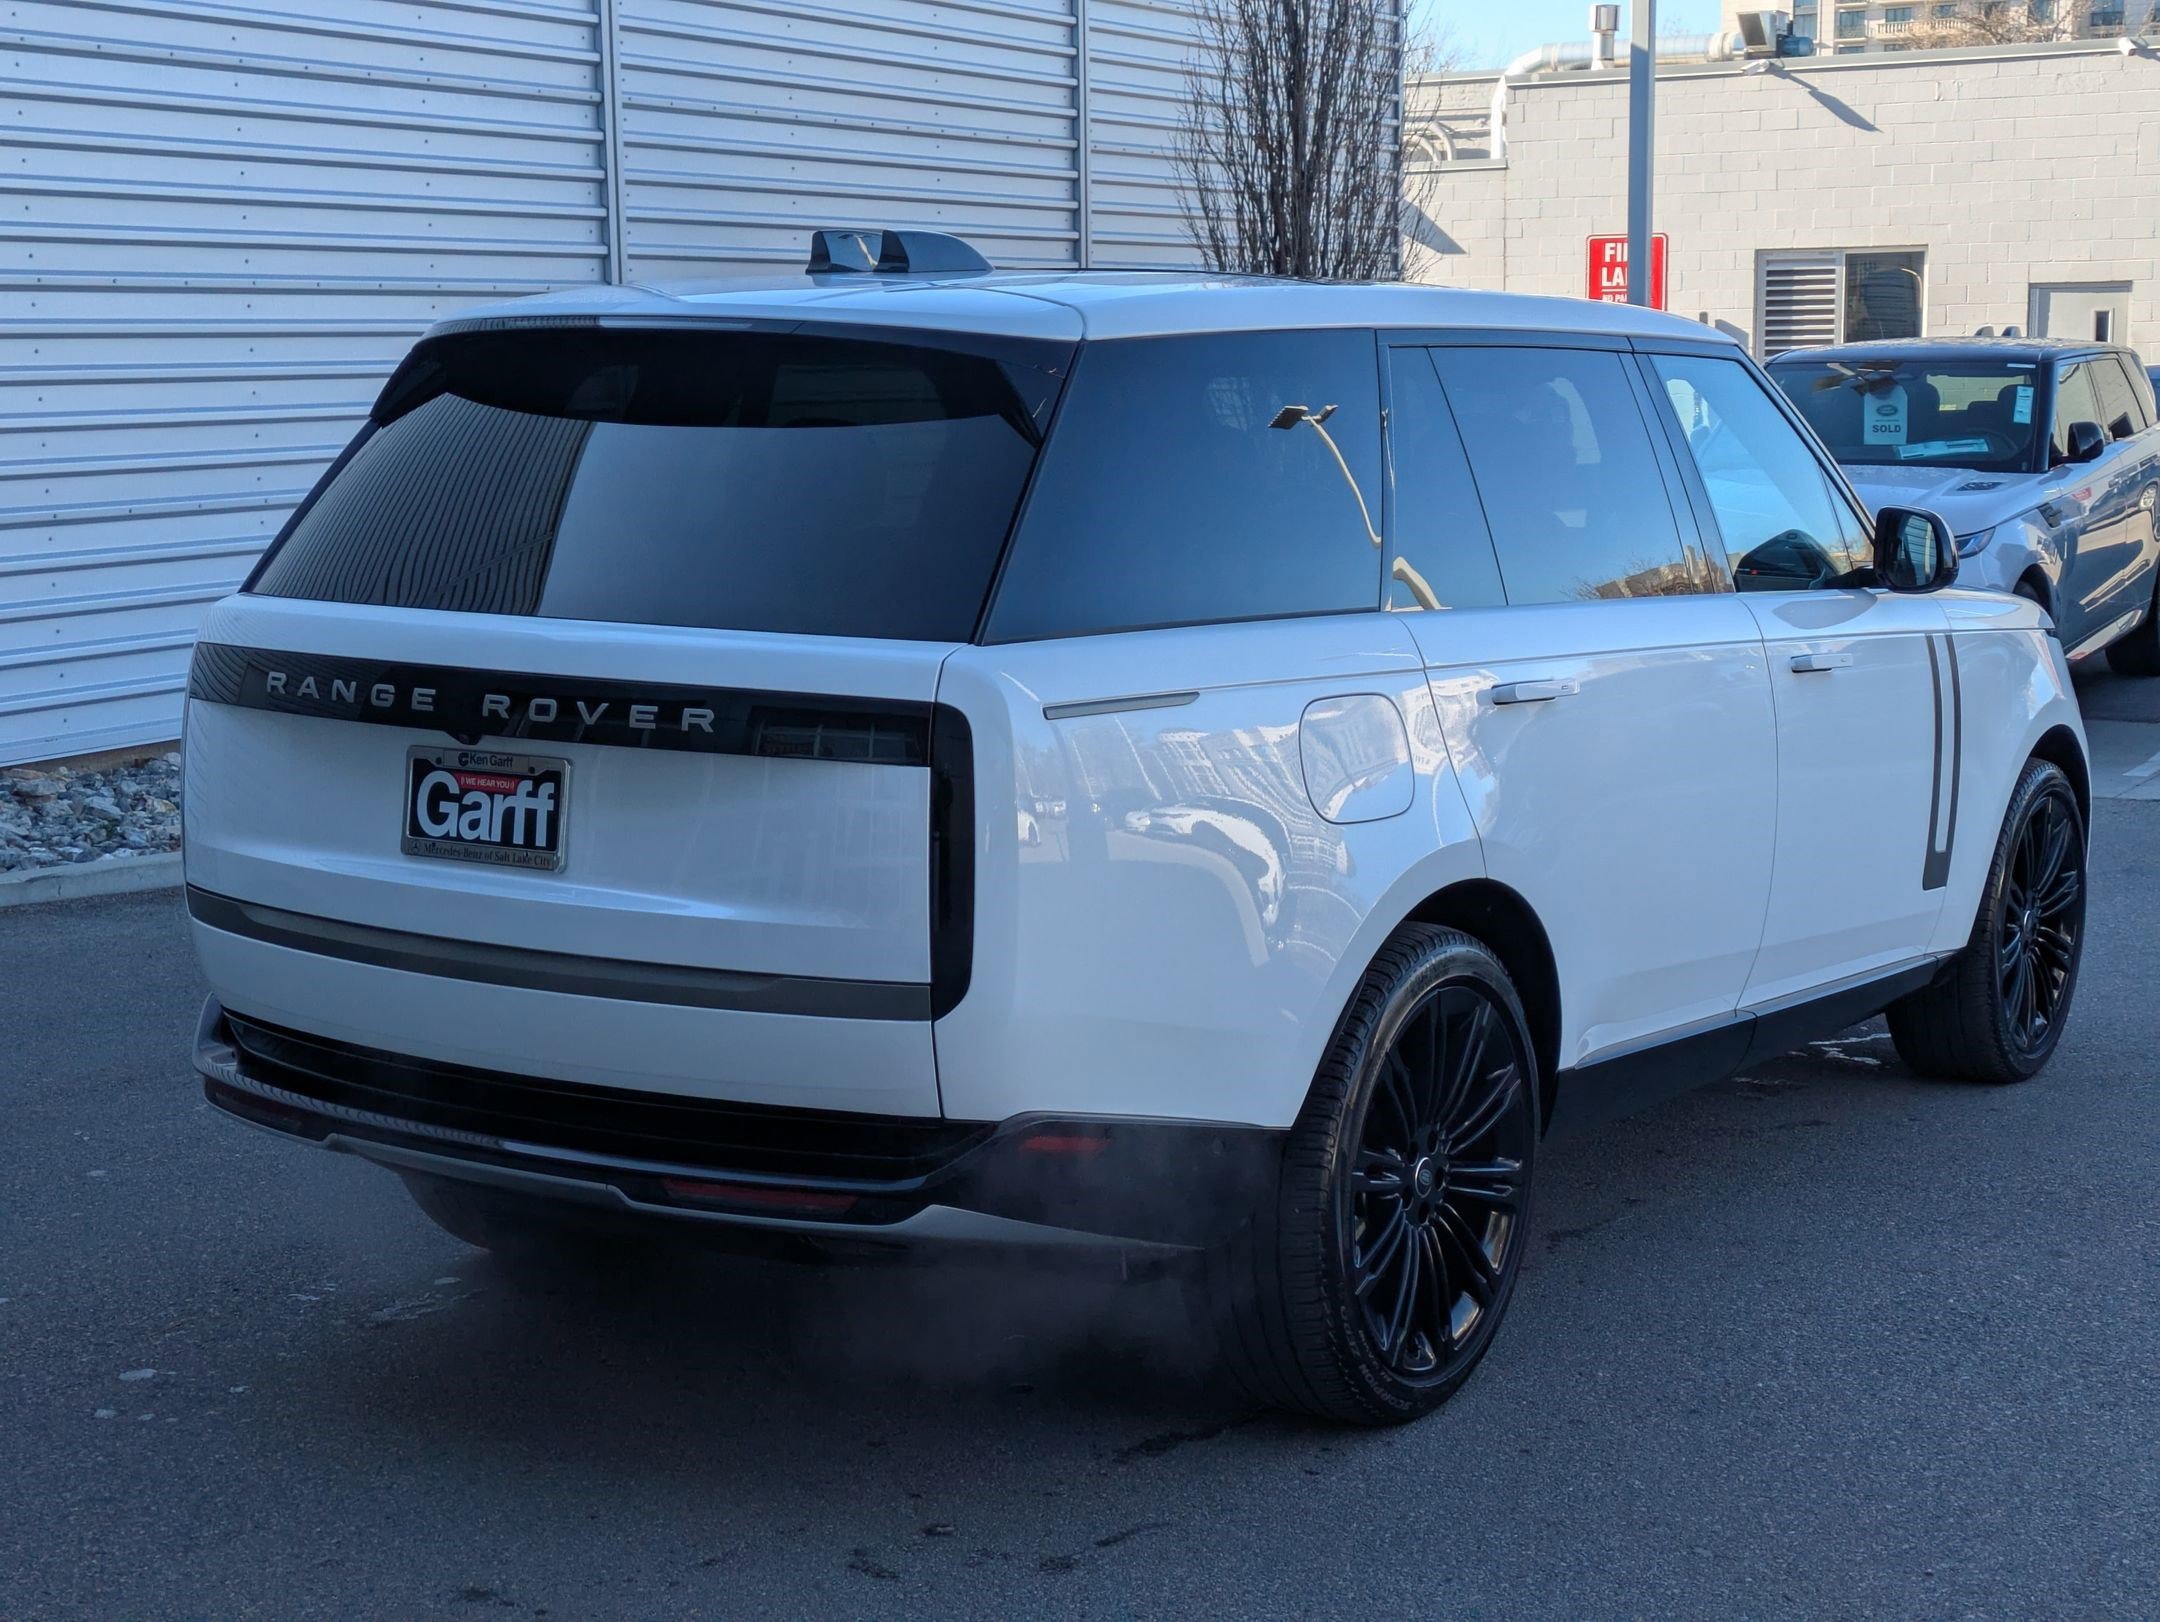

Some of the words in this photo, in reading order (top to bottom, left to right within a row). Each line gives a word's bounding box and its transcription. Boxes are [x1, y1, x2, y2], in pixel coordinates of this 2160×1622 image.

[1604, 242, 1628, 262] FI
[1601, 267, 1628, 286] LA
[1872, 424, 1901, 433] SOLD
[266, 671, 436, 712] RANGE
[482, 694, 715, 733] ROVER
[469, 752, 488, 766] Ken
[489, 755, 513, 767] Garff
[465, 776, 477, 786] WE
[477, 778, 495, 787] HEAR
[496, 780, 509, 788] YOU
[417, 770, 555, 847] Garff
[484, 850, 493, 861] of
[495, 852, 511, 863] Salt
[513, 854, 532, 866] Lake
[534, 855, 551, 868] City
